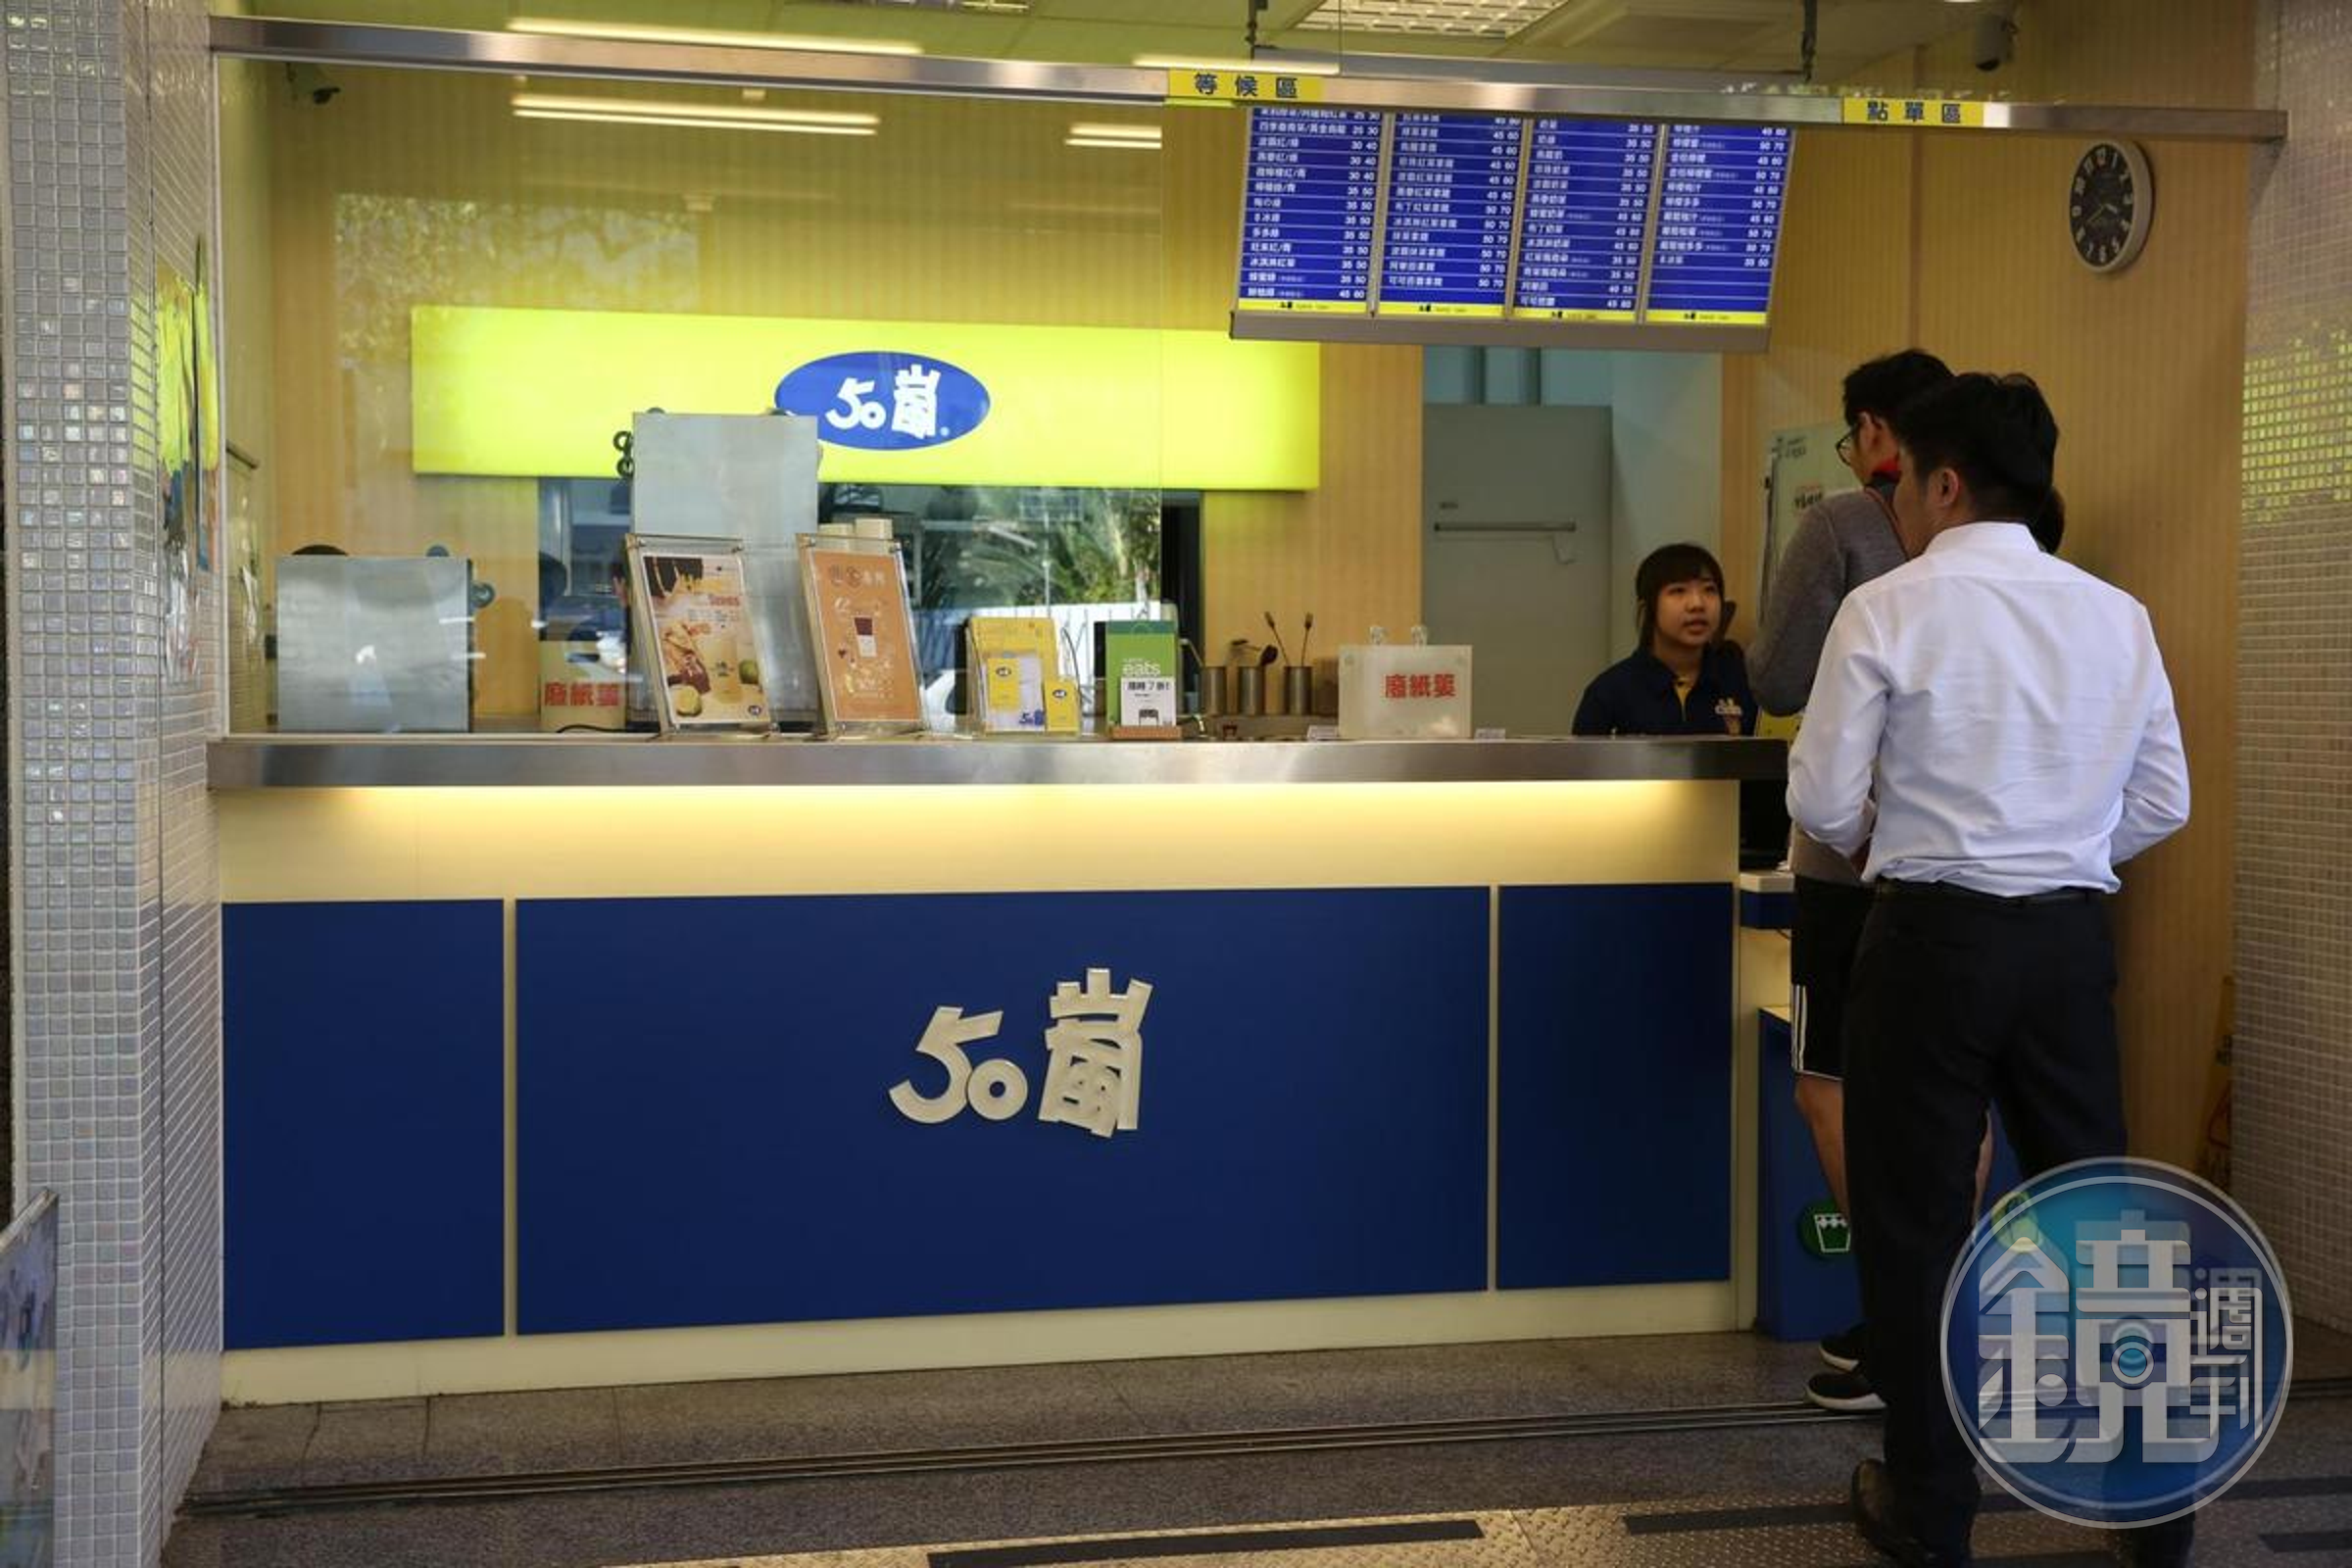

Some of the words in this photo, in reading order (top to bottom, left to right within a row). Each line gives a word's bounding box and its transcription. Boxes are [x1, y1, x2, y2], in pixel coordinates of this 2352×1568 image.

[1194, 73, 1298, 98] 等候區
[1868, 101, 1960, 124] 點單區
[824, 364, 941, 439] 50嵐
[889, 968, 1153, 1138] 50嵐
